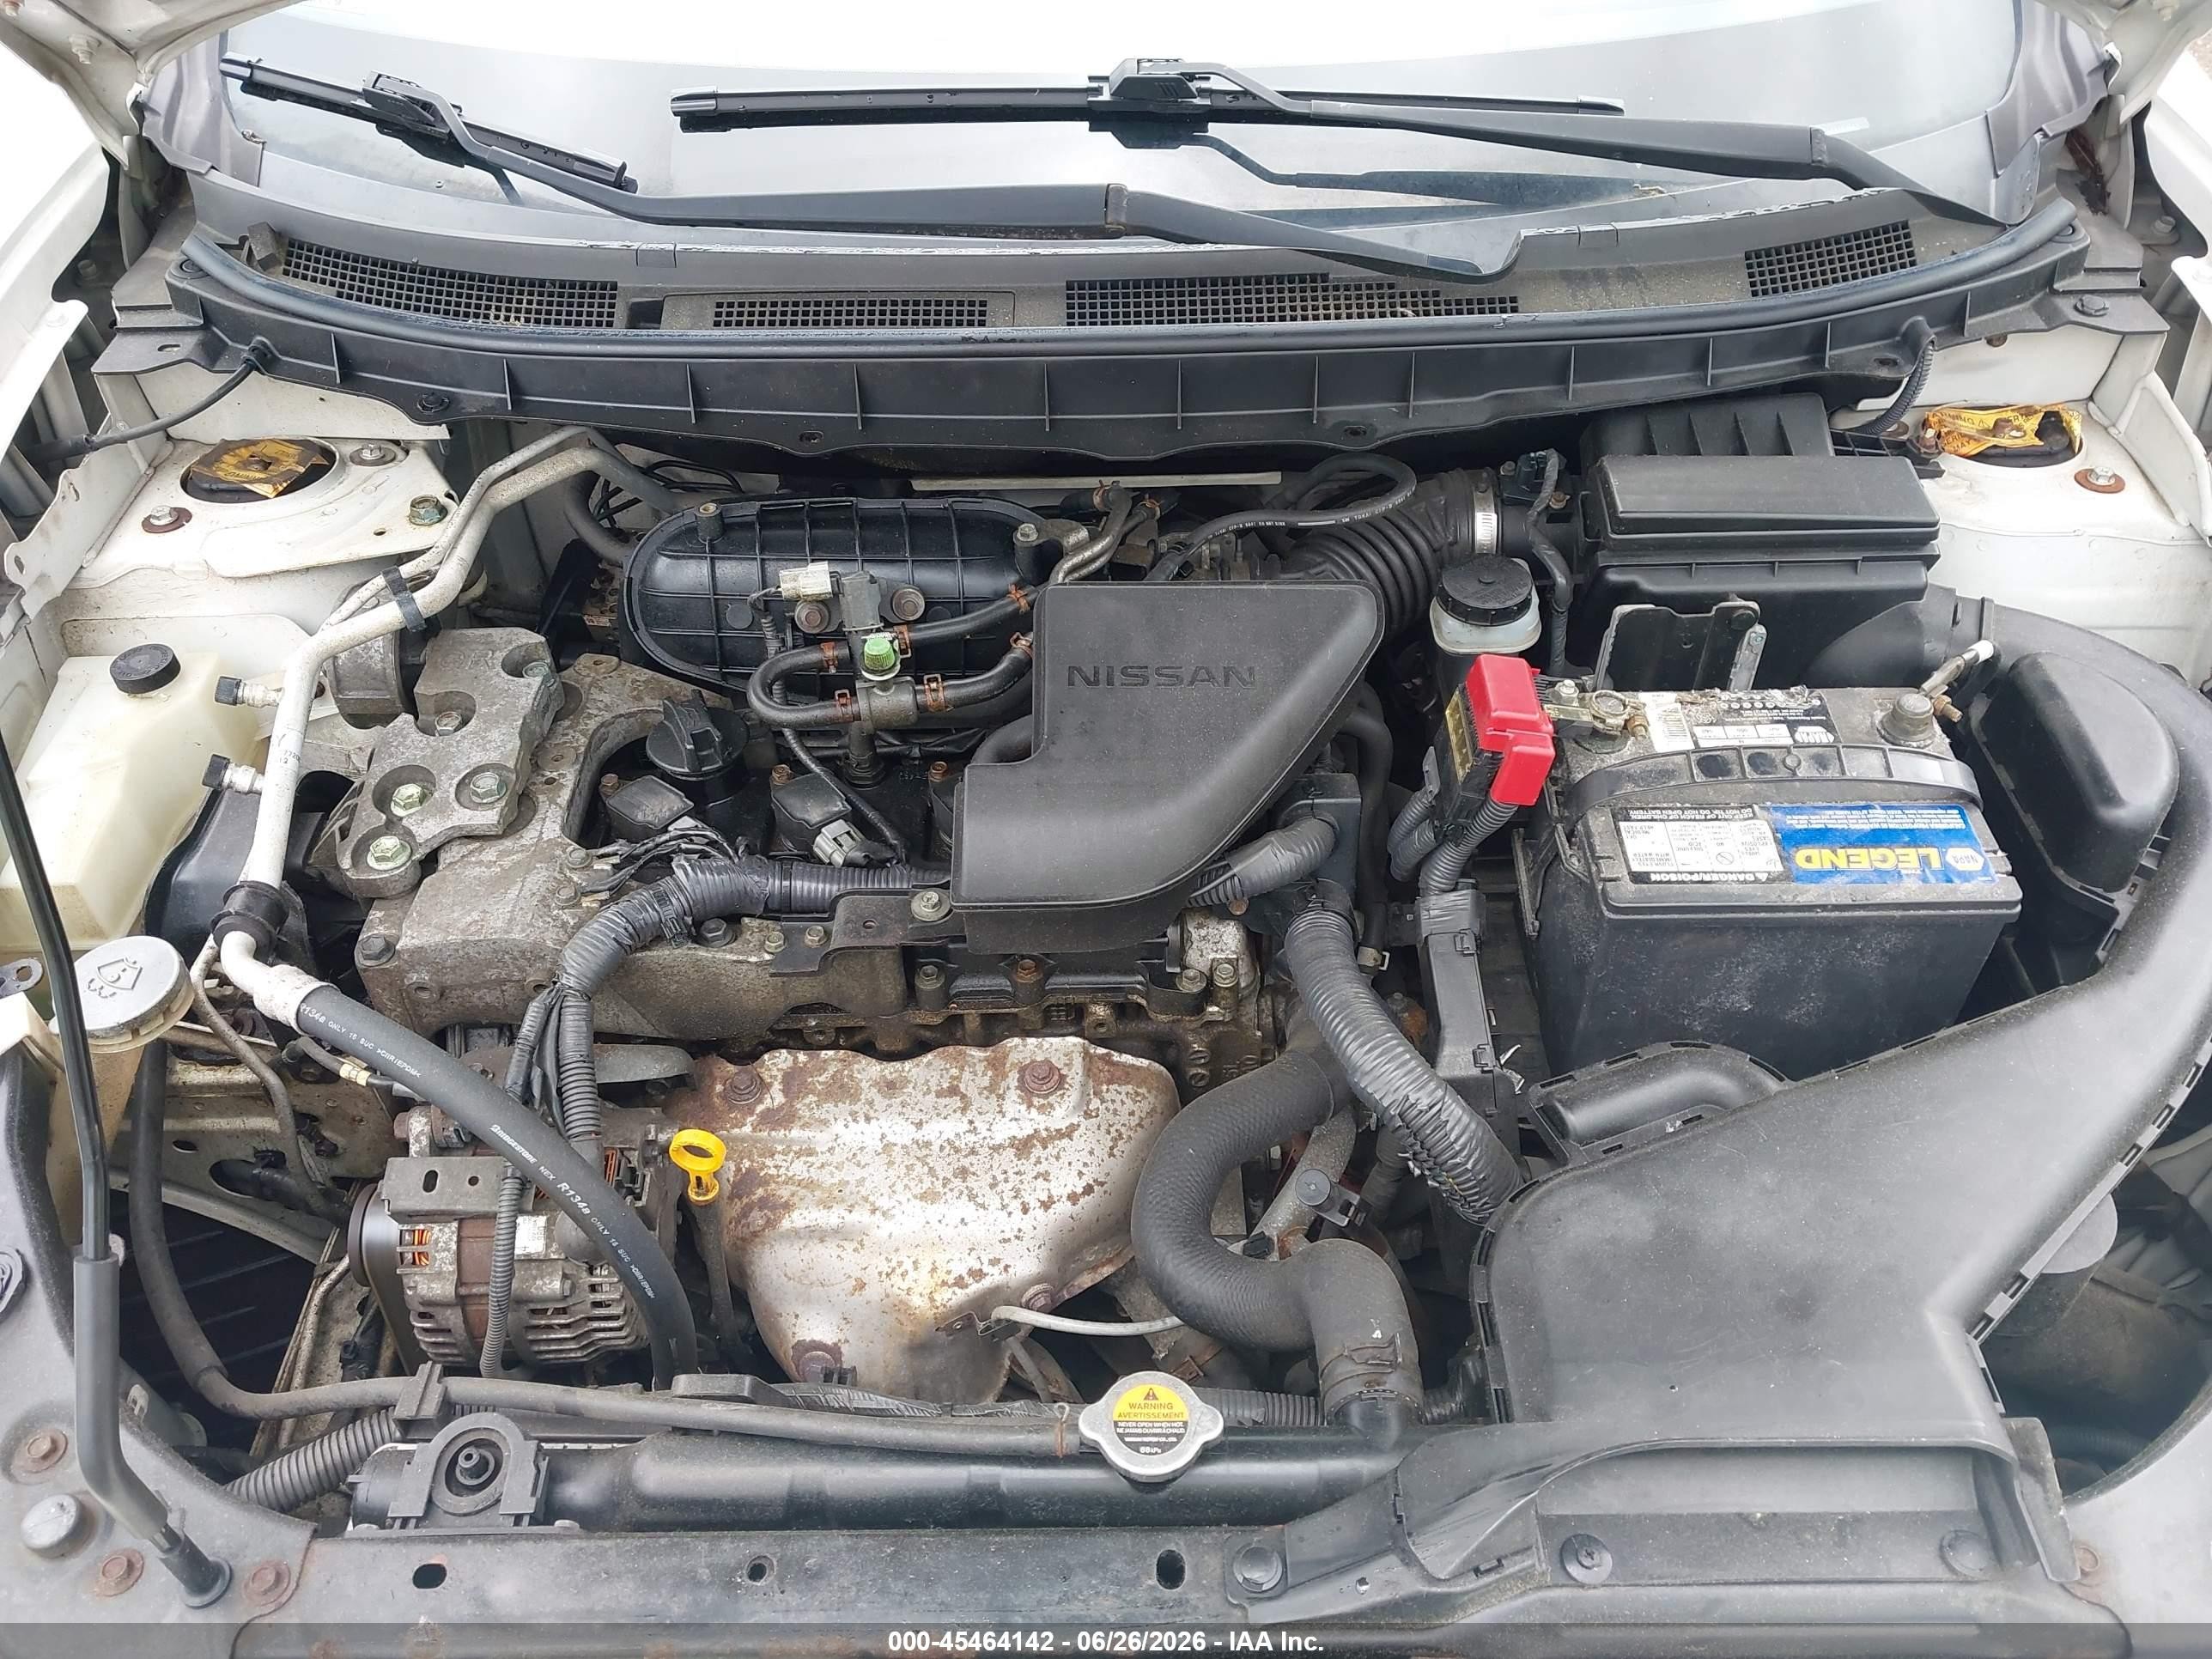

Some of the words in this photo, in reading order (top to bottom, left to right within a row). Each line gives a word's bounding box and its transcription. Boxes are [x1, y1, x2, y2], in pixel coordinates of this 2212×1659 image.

[1067, 665, 1255, 689] NISSAN
[1795, 847, 1945, 872] LEGEND
[1650, 872, 1755, 881] DANGER/POISON
[328, 1021, 346, 1034] ONLY
[360, 1038, 374, 1050] SUC
[489, 1124, 538, 1164] BRIDGESTONE
[538, 1165, 556, 1181] NEX
[591, 1217, 611, 1236] ONLY
[617, 1249, 631, 1262] SUC
